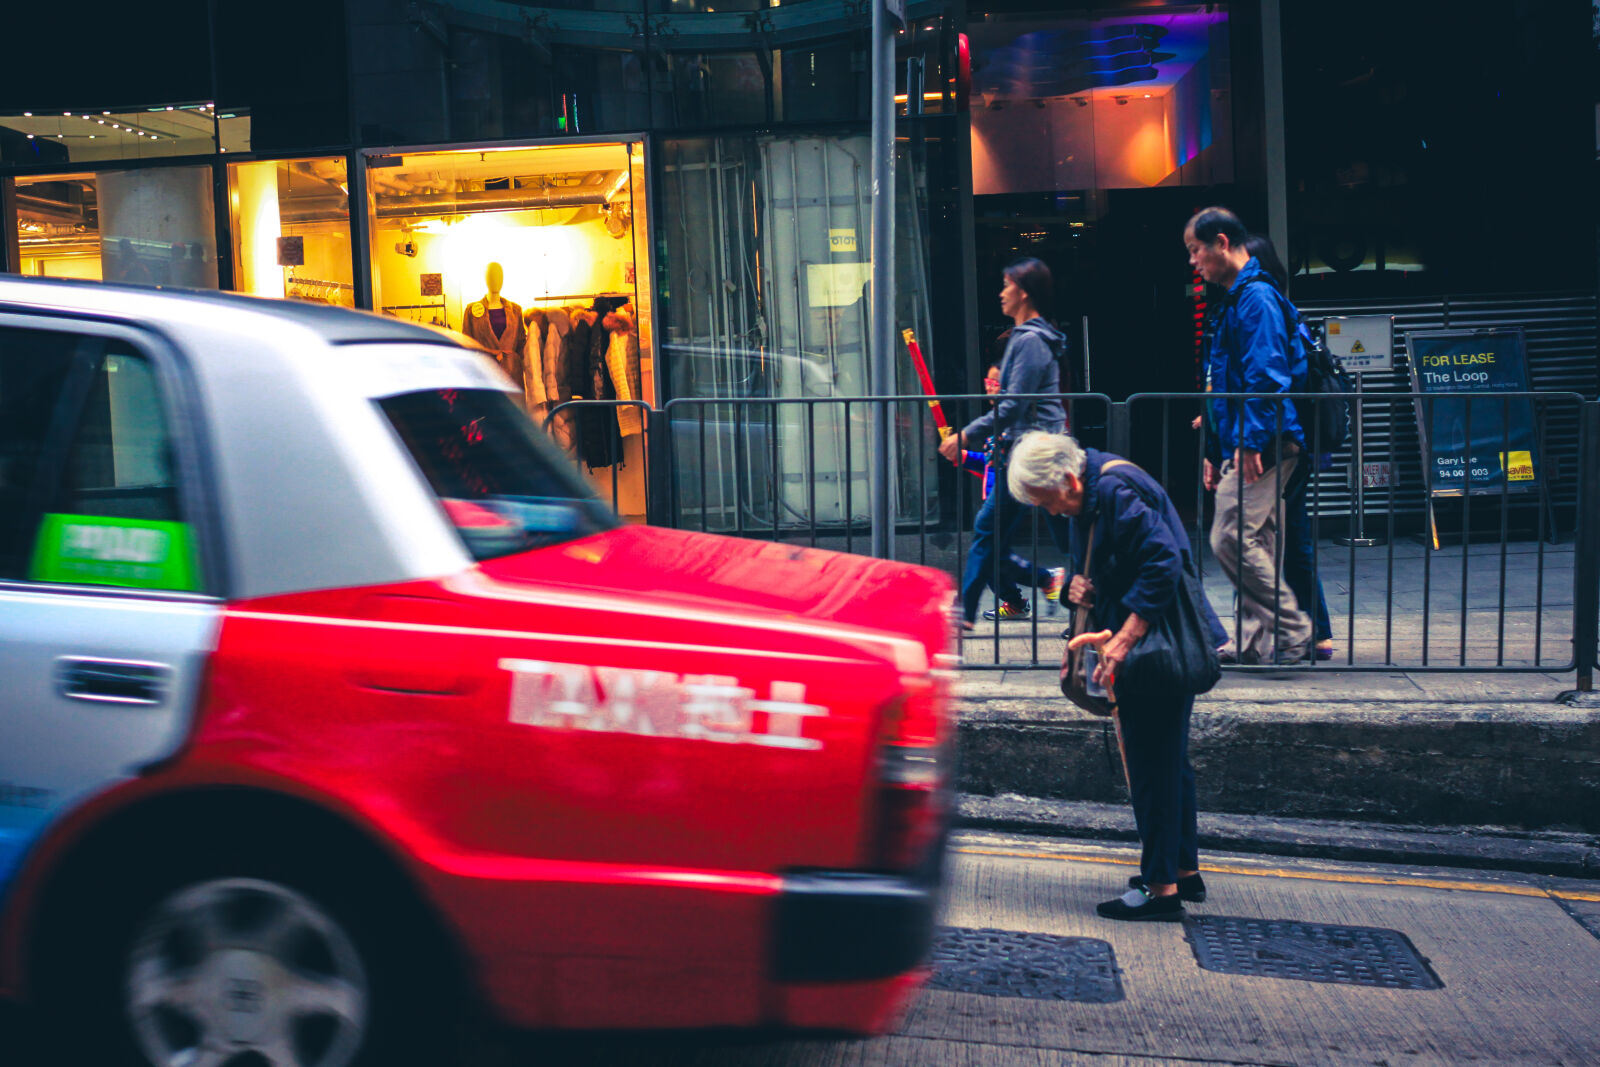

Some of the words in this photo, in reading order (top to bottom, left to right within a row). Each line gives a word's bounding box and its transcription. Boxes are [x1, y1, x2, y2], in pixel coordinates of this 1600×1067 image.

[1423, 355, 1450, 366] FOR
[1453, 353, 1496, 365] LEASE
[1424, 372, 1450, 383] The
[1453, 371, 1488, 383] Loop
[1437, 457, 1459, 466] Gary
[1460, 456, 1478, 464] Le
[1453, 469, 1466, 477] 00
[1471, 468, 1489, 476] 003
